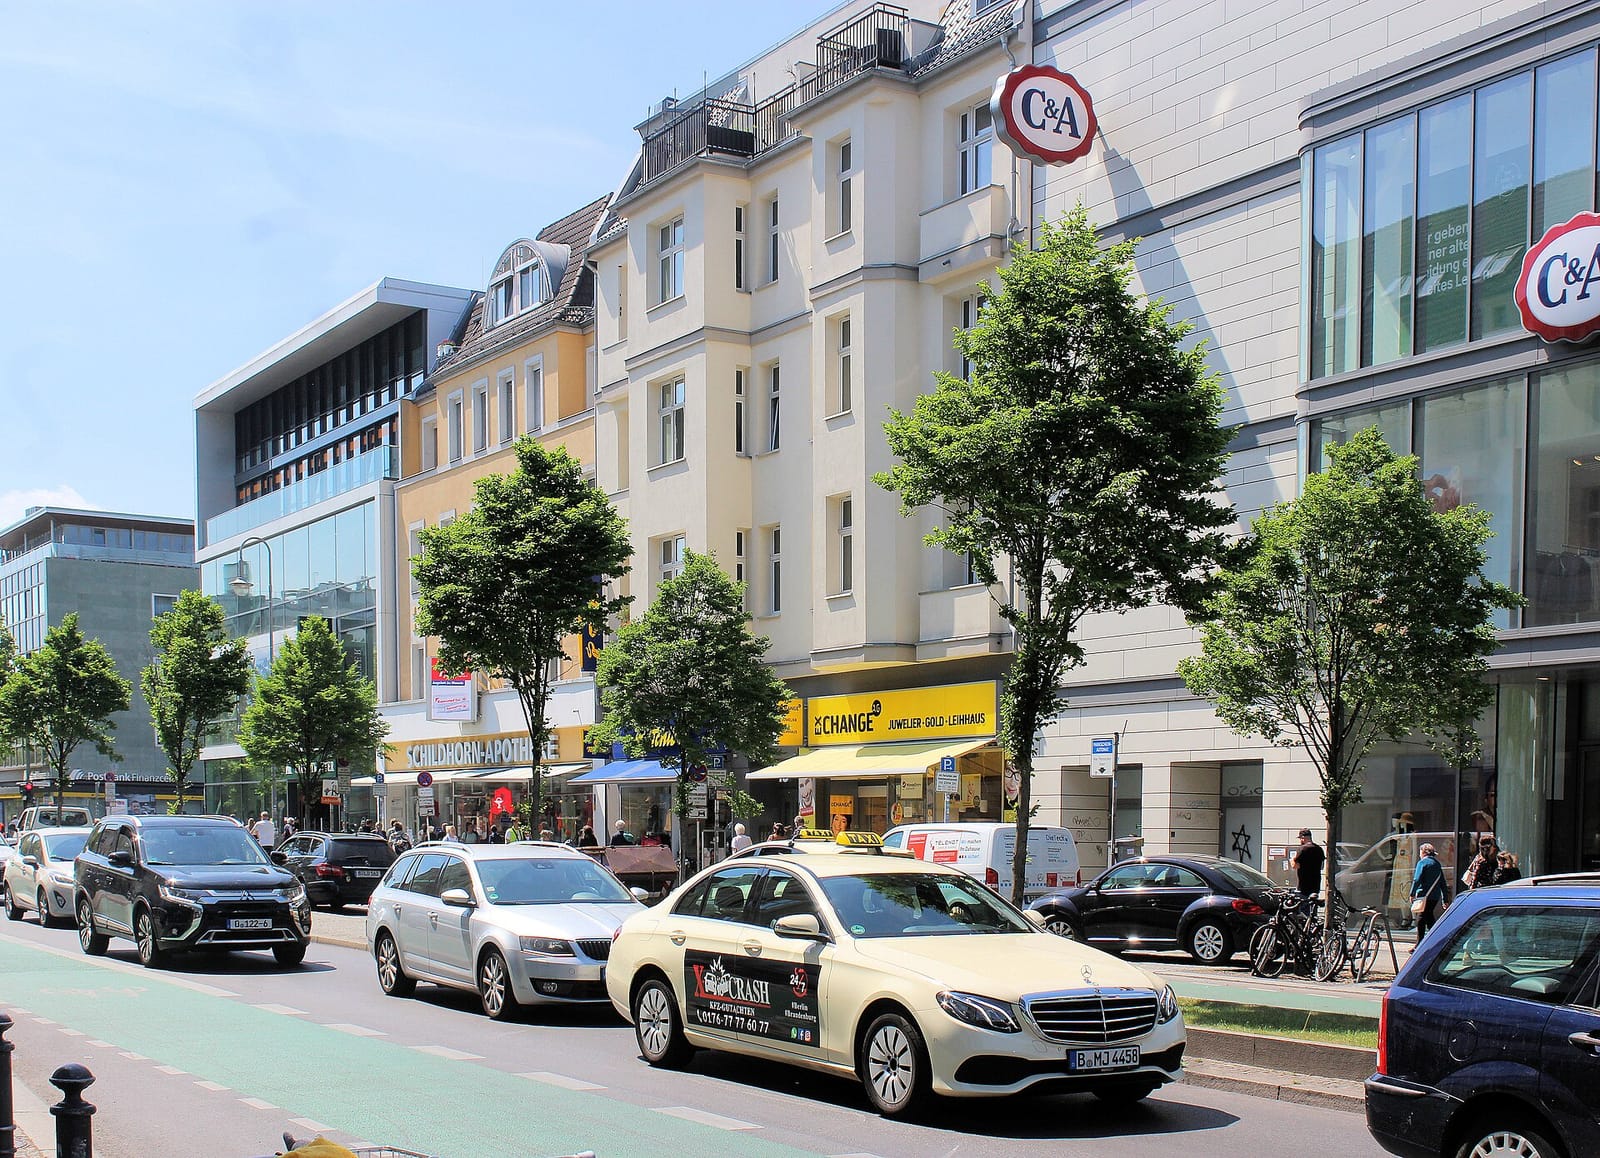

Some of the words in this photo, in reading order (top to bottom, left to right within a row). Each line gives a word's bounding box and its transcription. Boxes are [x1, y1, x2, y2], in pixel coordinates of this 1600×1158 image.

[1021, 88, 1081, 139] C&A
[1434, 223, 1468, 244] geben
[1537, 243, 1600, 308] C&A
[814, 713, 873, 735] EXCHANGE
[888, 717, 921, 730] JUWELIER
[925, 716, 944, 727] GOLD
[948, 713, 985, 726] LEIHHAUS
[407, 734, 559, 768] SCHILDHORN-APOTHE
[87, 772, 131, 781] Postank
[846, 833, 880, 844] TAXI
[728, 976, 771, 1005] CRASH
[789, 974, 806, 993] 24/7
[709, 1001, 755, 1016] KFZ-GUTACHTEN
[702, 1011, 733, 1028] 0176-77
[735, 1016, 745, 1029] 77
[747, 1018, 757, 1032] 60
[759, 1020, 769, 1034] 77
[1077, 1052, 1086, 1067] B
[1093, 1051, 1110, 1066] MJ
[1112, 1048, 1138, 1064] 4458
